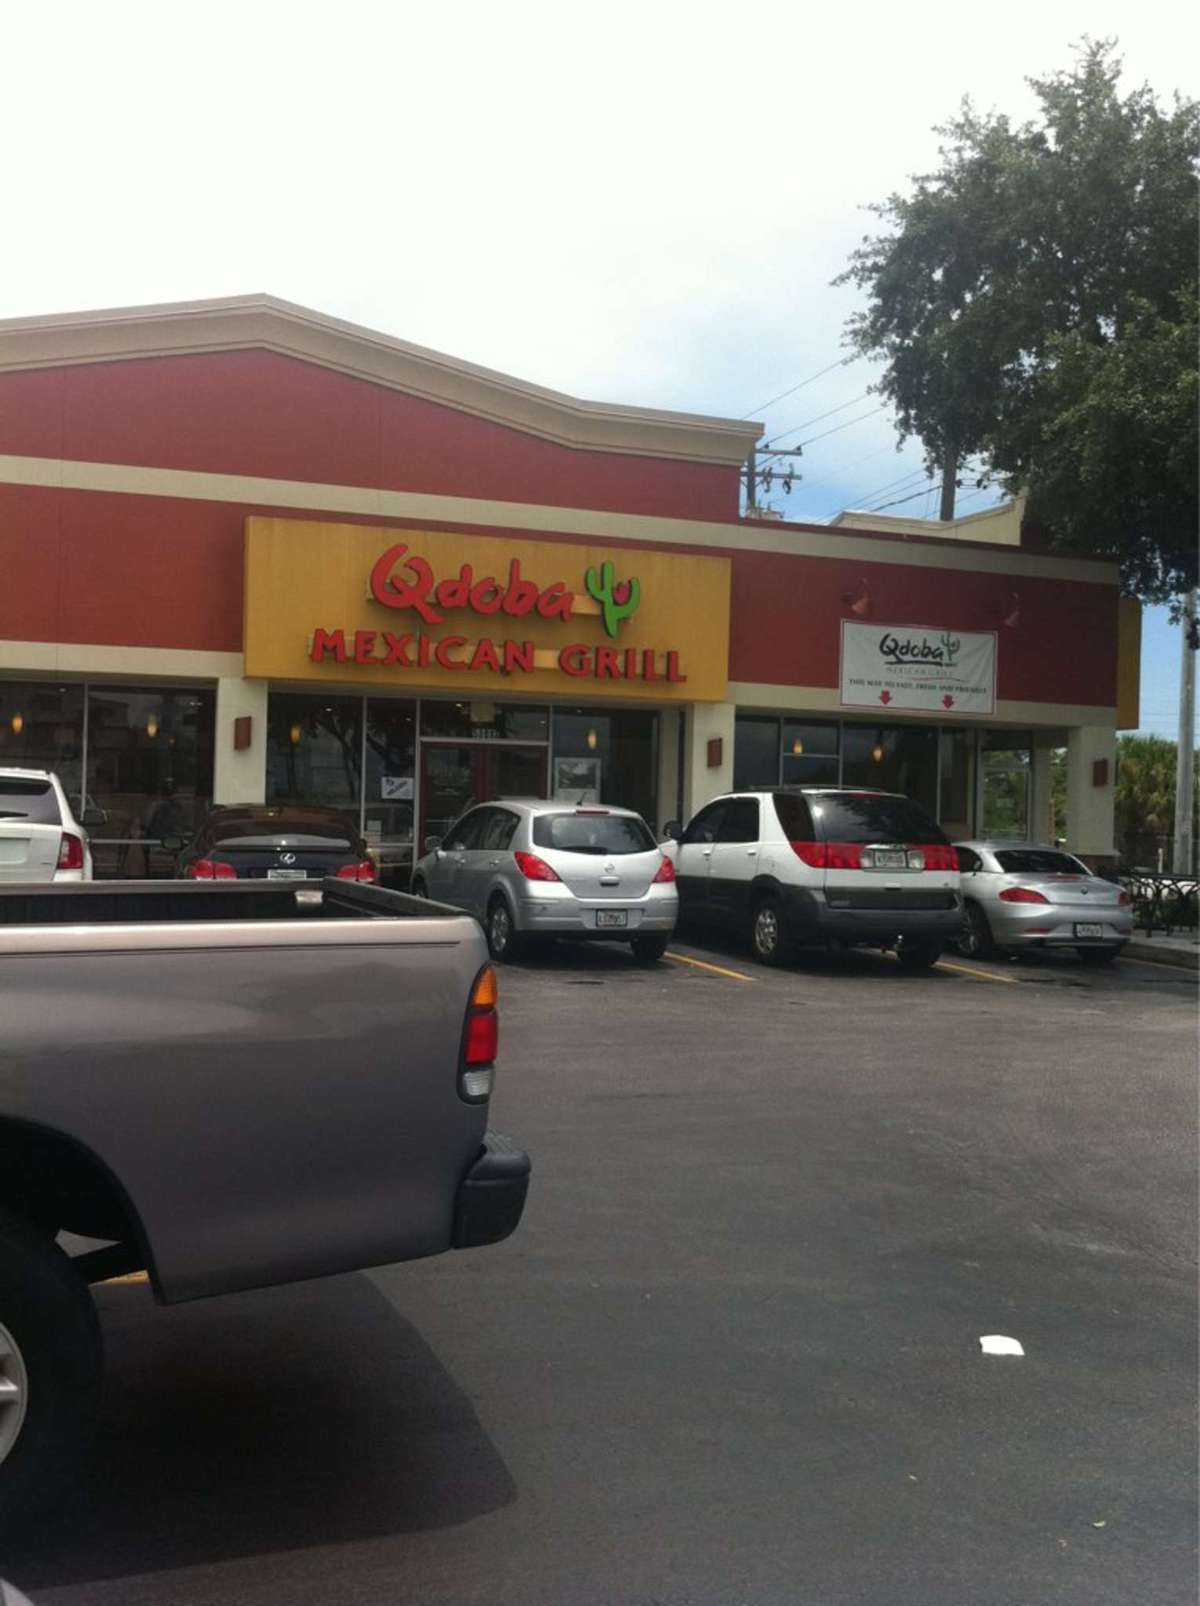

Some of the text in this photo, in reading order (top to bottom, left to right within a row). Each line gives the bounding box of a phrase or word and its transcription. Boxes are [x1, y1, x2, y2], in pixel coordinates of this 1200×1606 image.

[370, 543, 575, 624] Qdoba
[309, 628, 688, 683] MEXICAN GRILL
[879, 633, 944, 662] Qdoba
